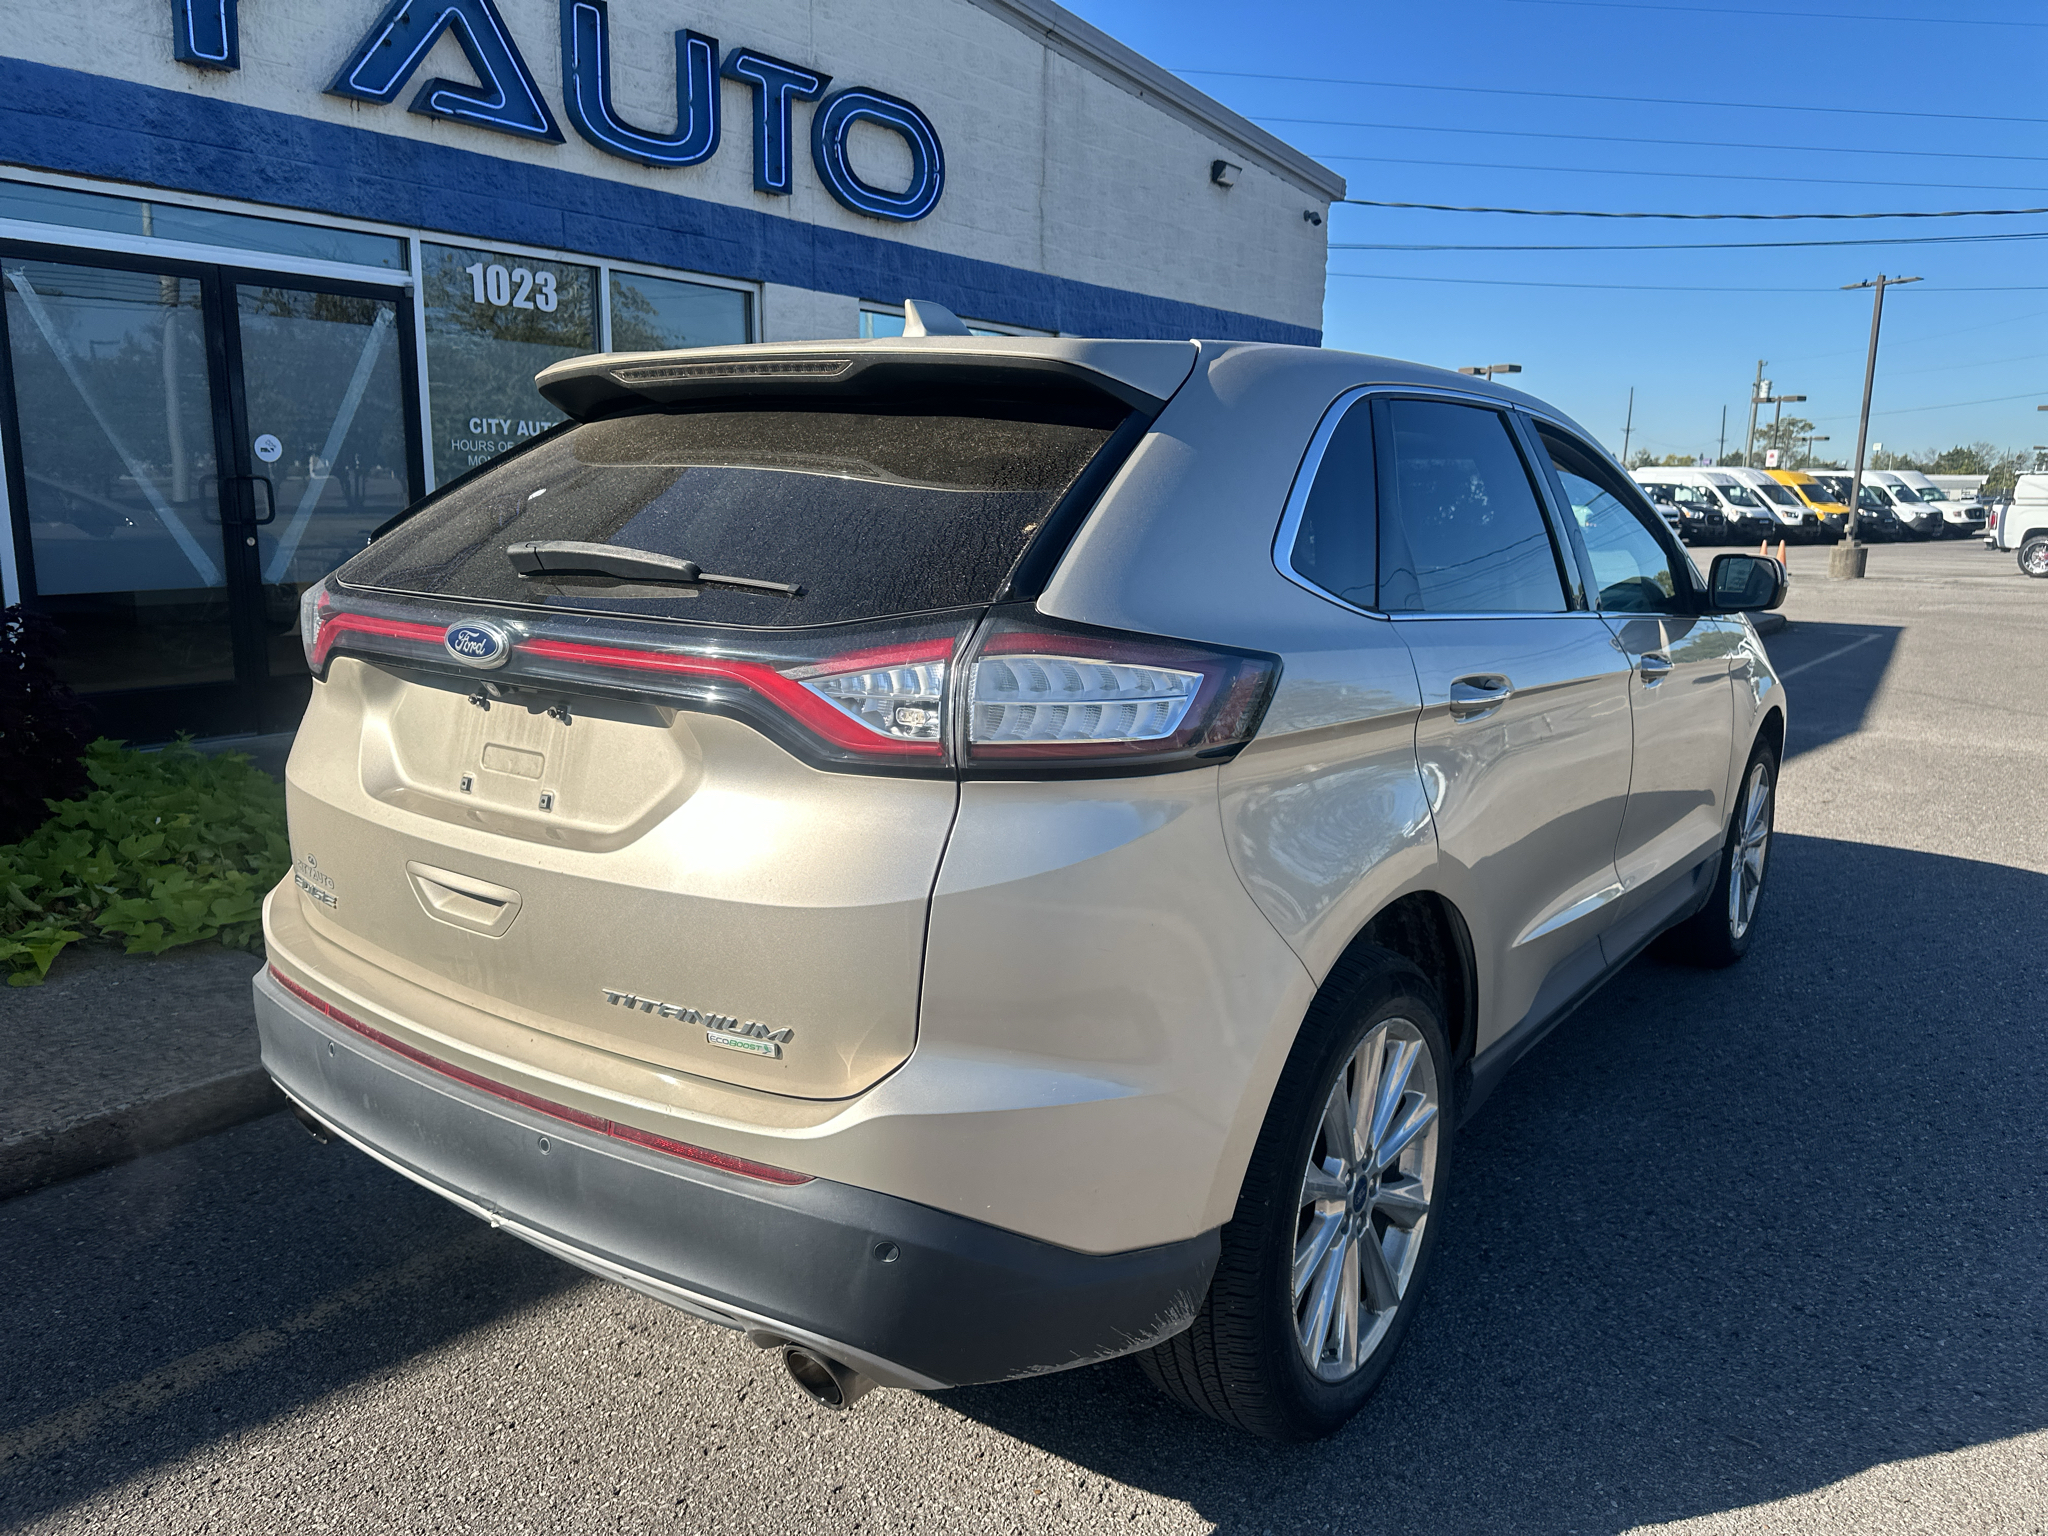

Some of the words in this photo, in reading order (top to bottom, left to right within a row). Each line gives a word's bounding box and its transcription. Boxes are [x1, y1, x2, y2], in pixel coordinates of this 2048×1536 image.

[323, 0, 946, 222] AUTO
[466, 262, 558, 313] 1023
[469, 417, 512, 435] CITY
[451, 439, 495, 452] HOURS
[468, 455, 491, 466] MO
[455, 630, 487, 655] Ford
[295, 874, 338, 909] EDGE
[602, 988, 795, 1044] TITANIUM
[709, 1035, 763, 1052] ECOBOOST
